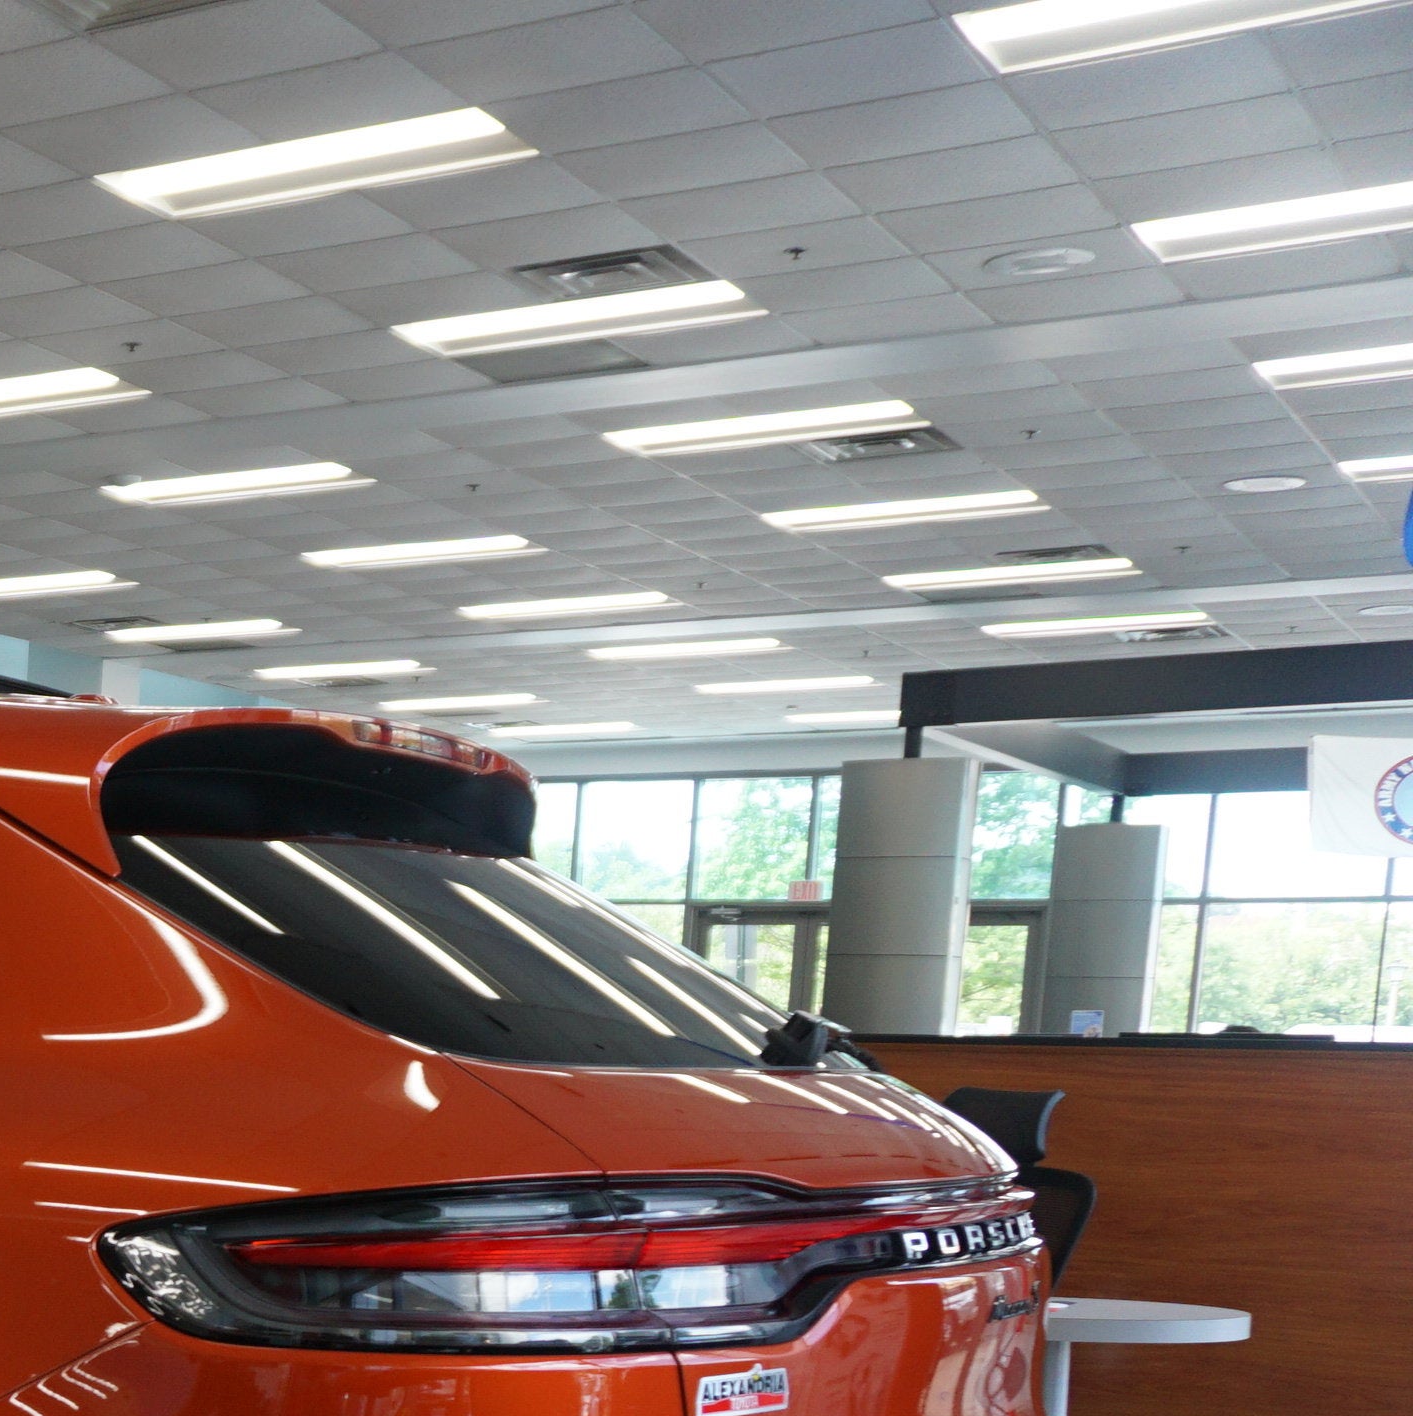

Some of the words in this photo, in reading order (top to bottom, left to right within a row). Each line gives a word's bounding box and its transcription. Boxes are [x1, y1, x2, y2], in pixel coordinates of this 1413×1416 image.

[1378, 772, 1400, 807] ARMY
[792, 882, 818, 900] EXIT
[902, 1211, 1036, 1262] PORSCHE
[702, 1374, 786, 1402] ALEXANDRIA
